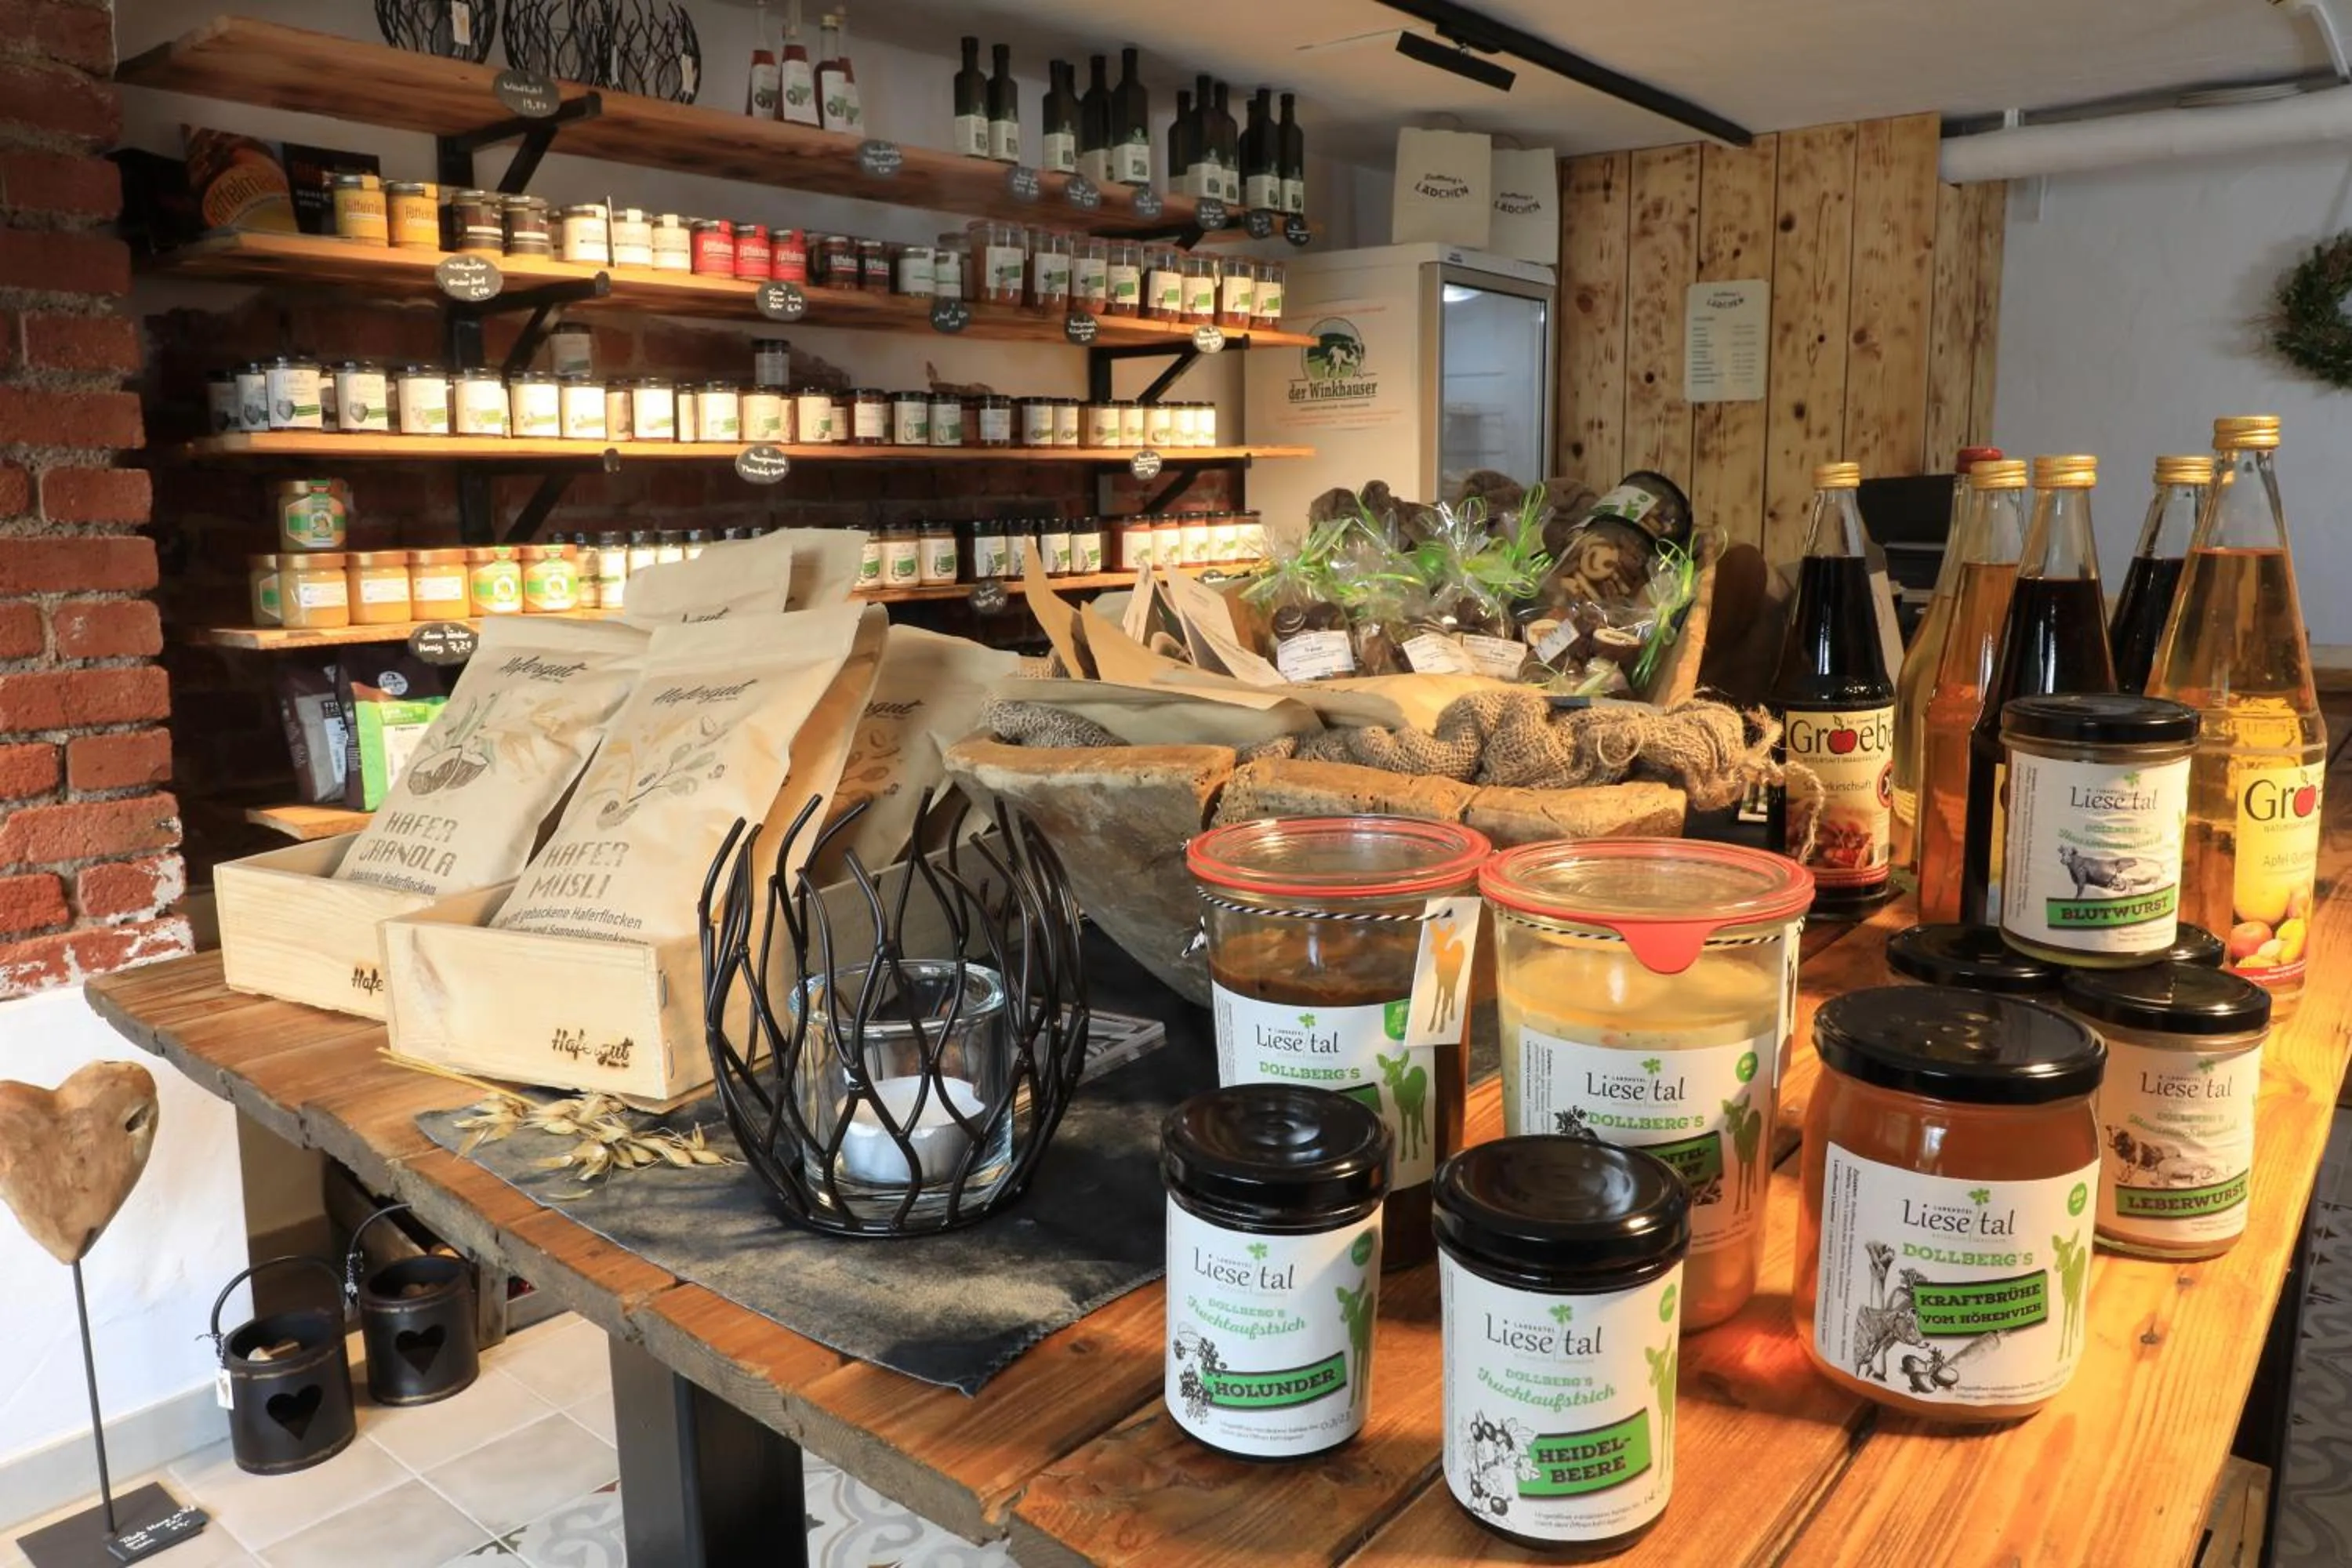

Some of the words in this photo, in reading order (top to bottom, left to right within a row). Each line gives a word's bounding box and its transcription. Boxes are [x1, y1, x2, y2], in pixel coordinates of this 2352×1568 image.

[1288, 383, 1307, 401] der
[1309, 380, 1378, 398] Winkhauser
[384, 811, 459, 843] HAFER
[358, 840, 458, 877] GRANOLA
[543, 841, 630, 868] HAFER
[528, 869, 612, 900] MÜSLI
[571, 907, 643, 930] Haferflocken
[2060, 897, 2169, 920] BLUTWURST
[2127, 1181, 2246, 1210] LEBERWURST
[1920, 1283, 2041, 1306] KRAFTBRÜHE
[1922, 1314, 1955, 1324] VOM
[1960, 1303, 2042, 1324] HÖHENVIEH
[1214, 1367, 1337, 1398] HOLUNDER
[1537, 1436, 1632, 1464] HEIDEL-
[1551, 1455, 1627, 1483] BEERE
